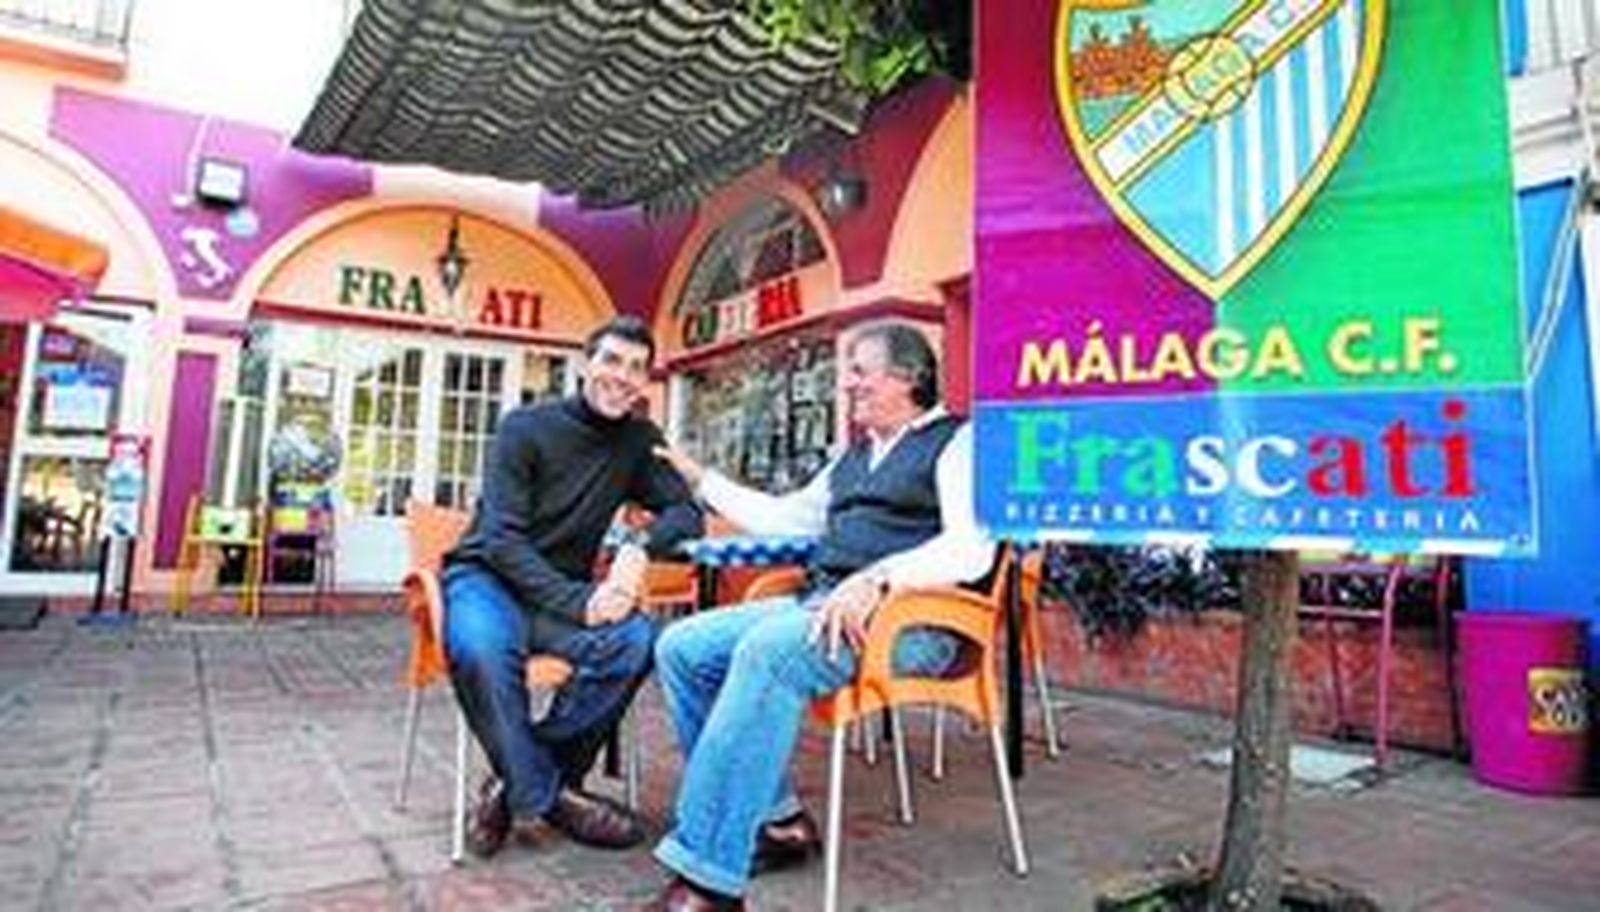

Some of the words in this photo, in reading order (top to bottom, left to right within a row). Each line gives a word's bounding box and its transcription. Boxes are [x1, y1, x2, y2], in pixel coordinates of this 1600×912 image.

[1017, 320, 1304, 388] MÁLAGA
[1327, 318, 1459, 375] C.F.
[1008, 399, 1479, 499] Frascati
